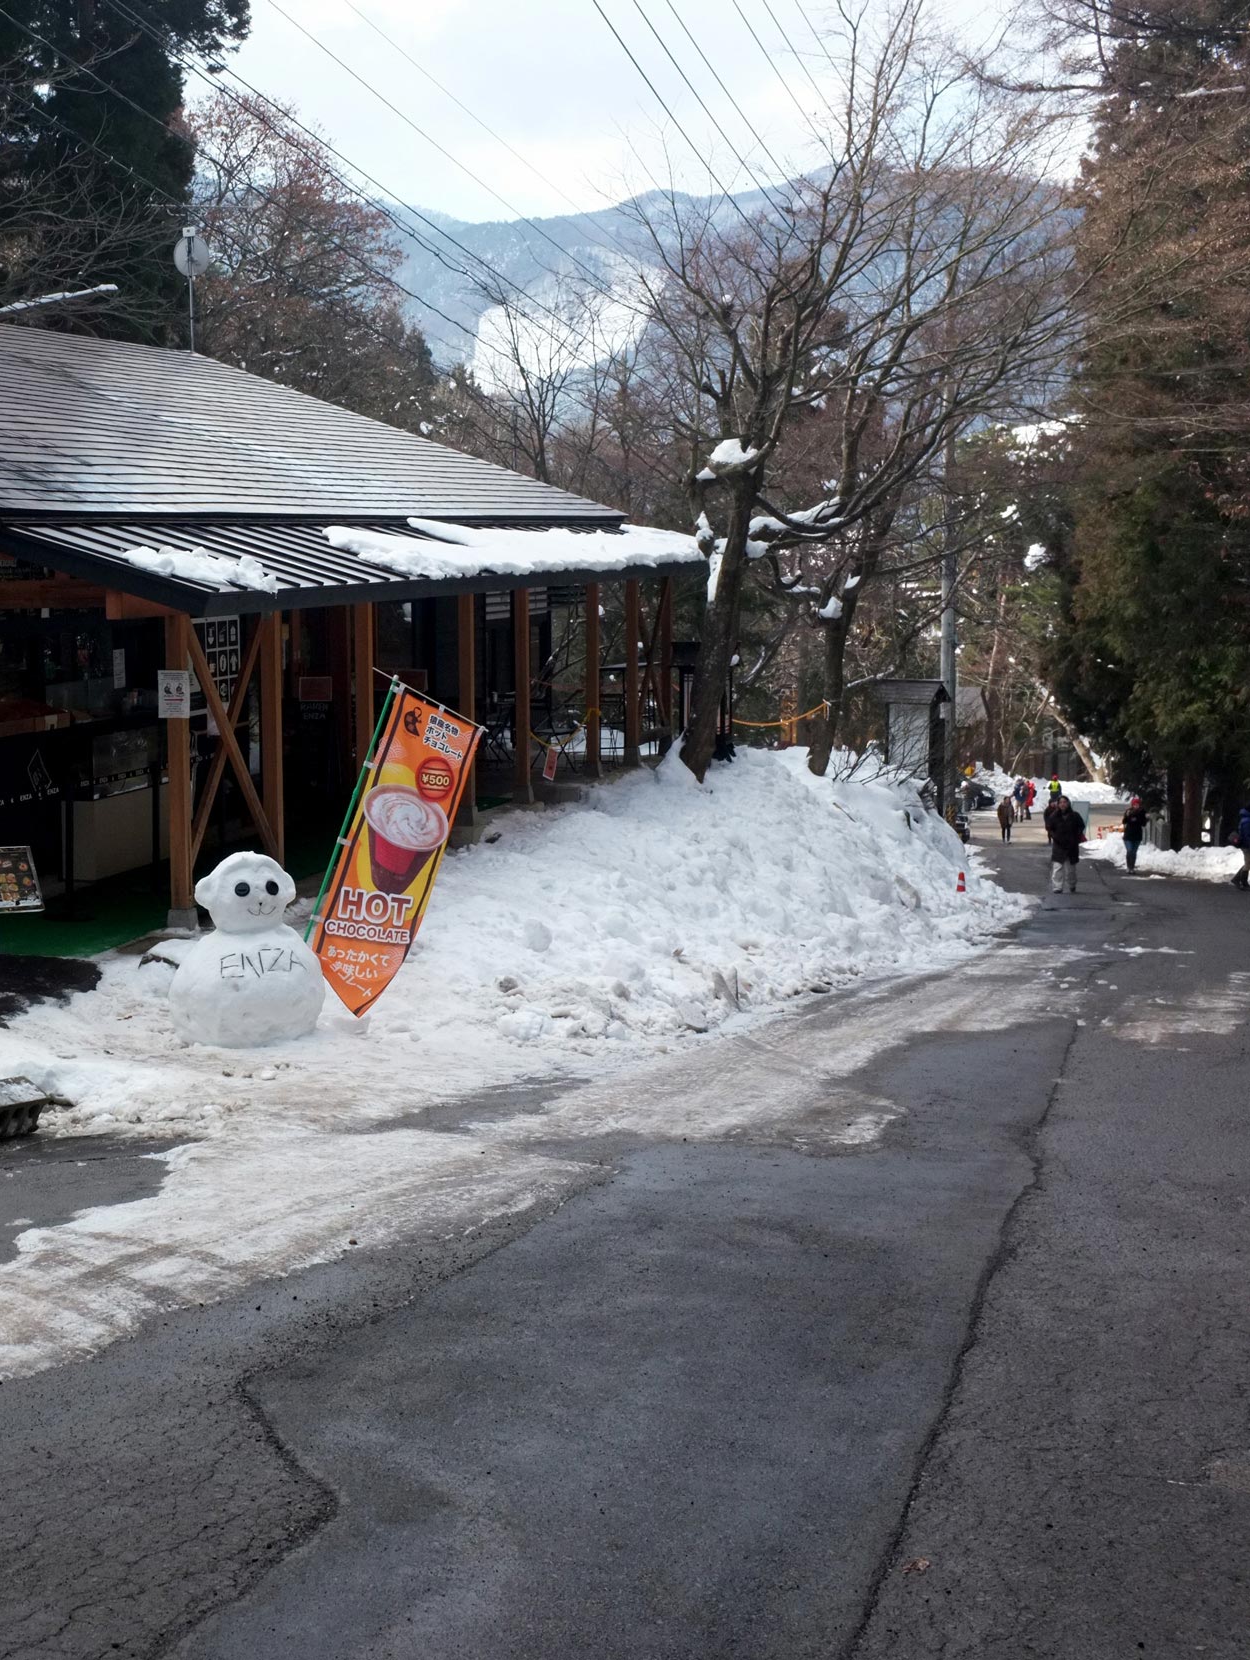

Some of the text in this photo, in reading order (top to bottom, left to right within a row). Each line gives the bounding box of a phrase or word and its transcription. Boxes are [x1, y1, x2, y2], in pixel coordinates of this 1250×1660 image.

[426, 726, 447, 740] ホット
[423, 736, 462, 759] チョコレート
[421, 773, 450, 786] ¥500
[338, 887, 413, 926] HOT
[325, 920, 410, 944] CHOCOLATE
[220, 948, 307, 979] ENZA
[327, 945, 390, 966] あったかくて
